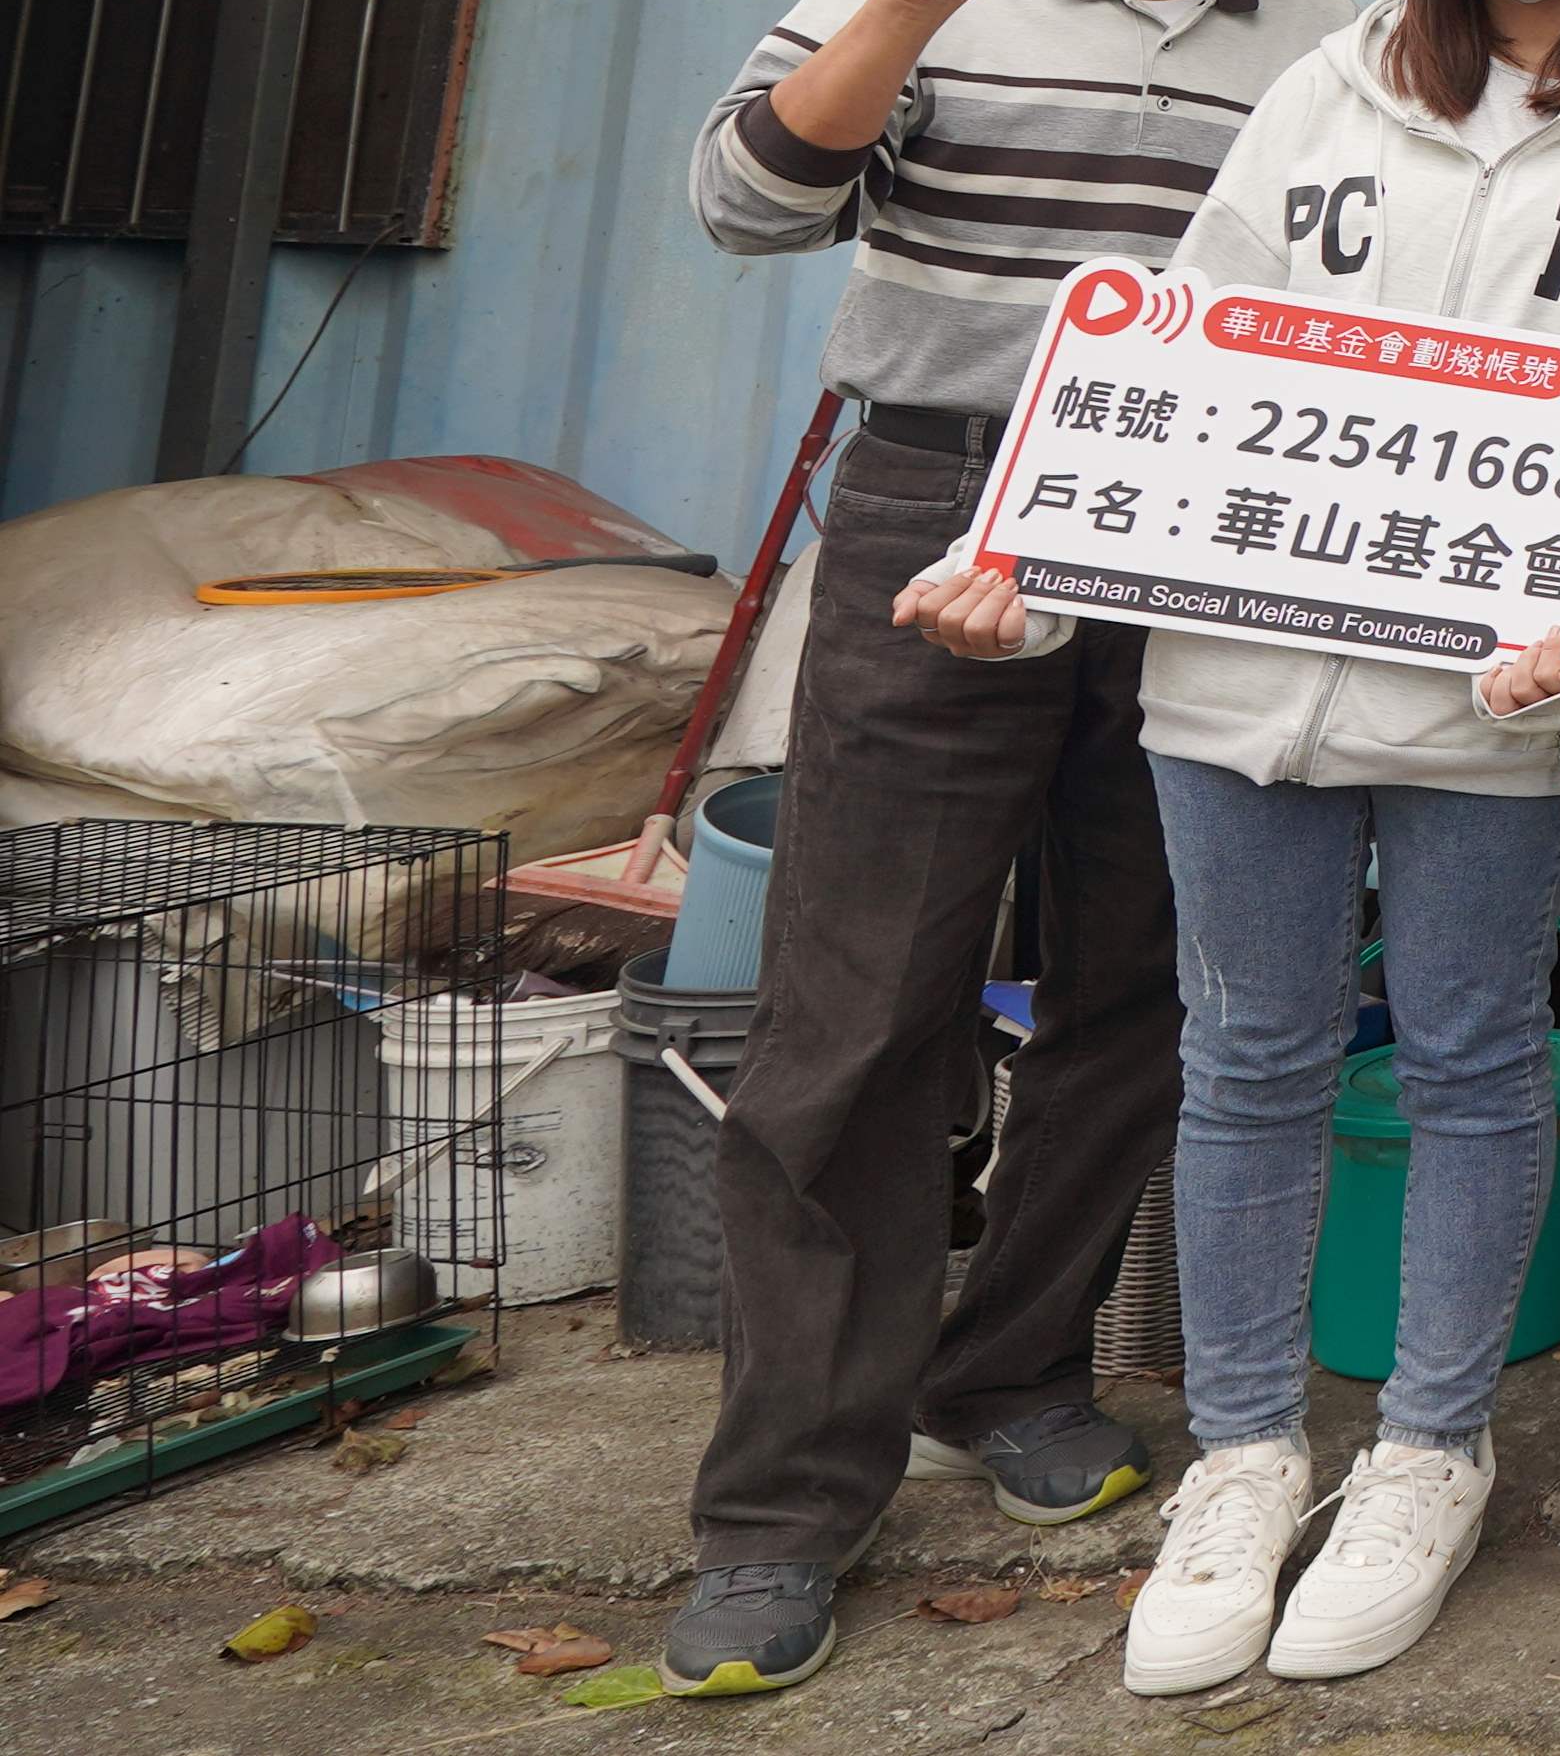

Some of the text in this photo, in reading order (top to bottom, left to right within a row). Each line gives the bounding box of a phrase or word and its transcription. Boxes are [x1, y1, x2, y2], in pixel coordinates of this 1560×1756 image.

[1219, 307, 1560, 391] 華山基金會劃撥帳號
[1021, 565, 1484, 654] Huashan Social Welfare Foundation
